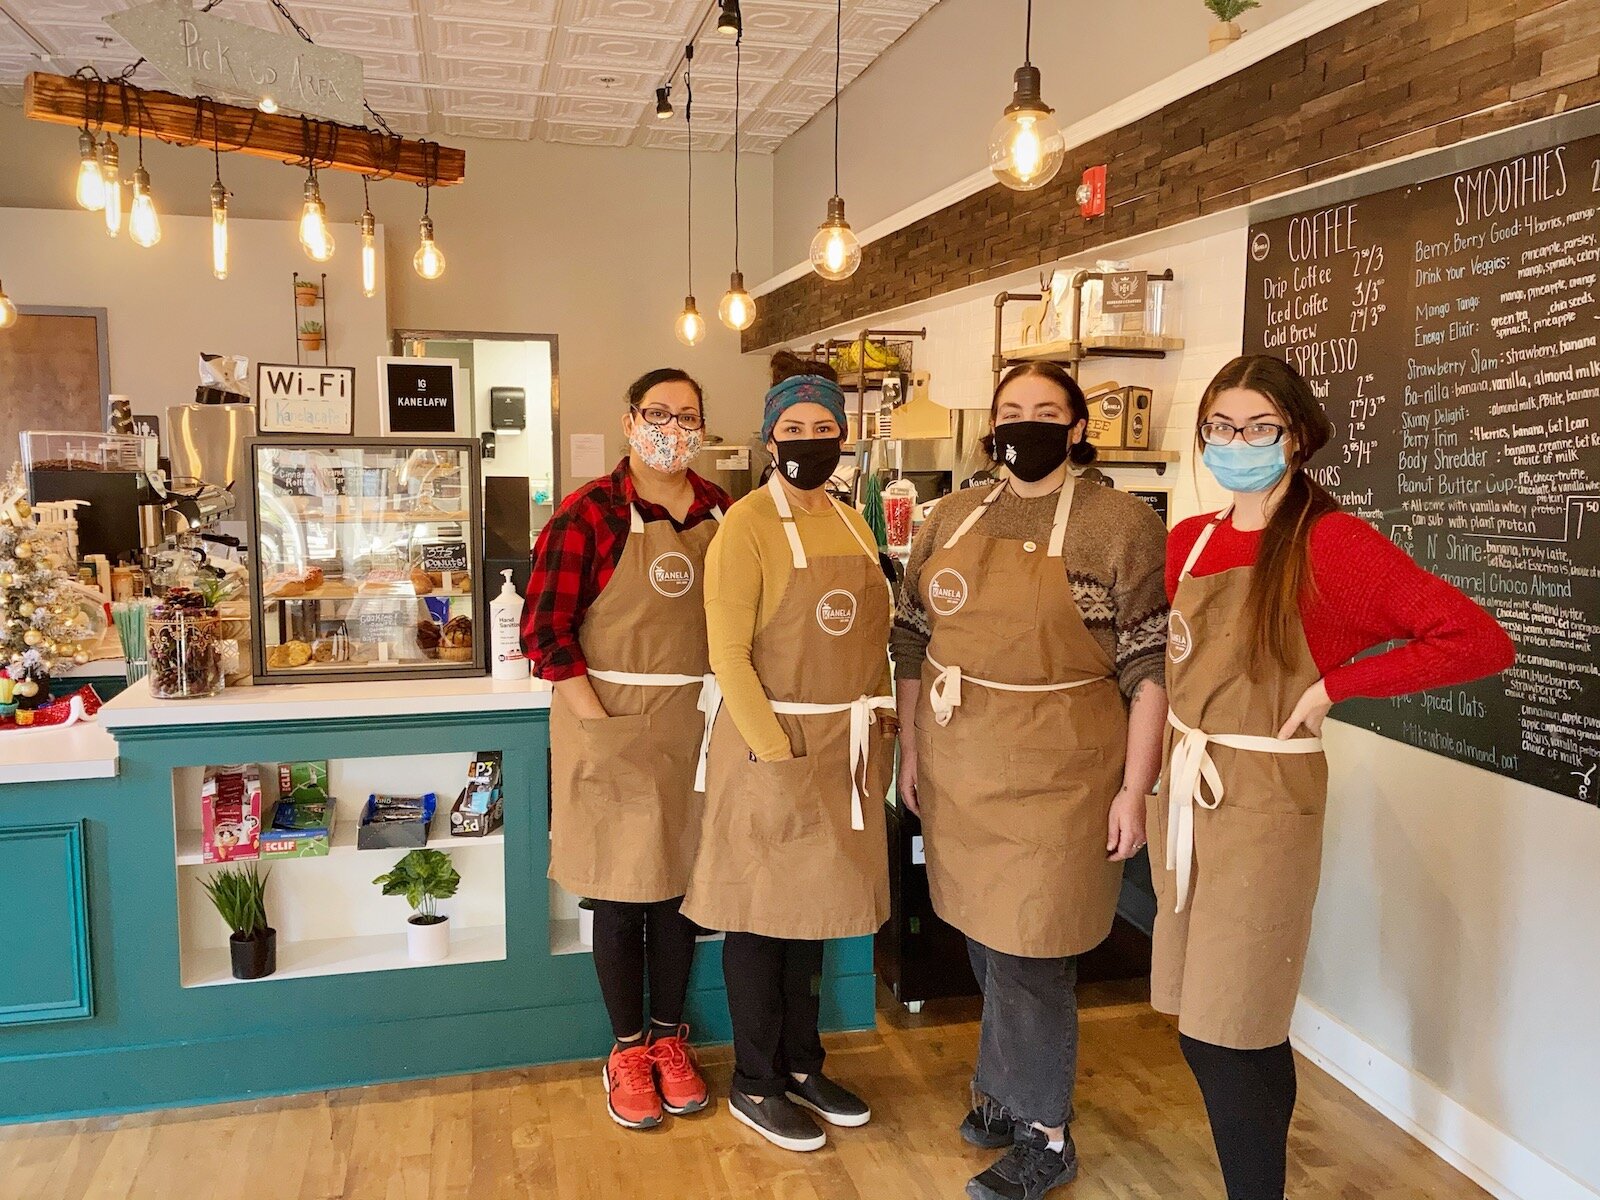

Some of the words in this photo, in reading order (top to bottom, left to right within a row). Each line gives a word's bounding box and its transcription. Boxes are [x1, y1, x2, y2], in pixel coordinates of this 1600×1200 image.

[1454, 146, 1567, 226] SMOOTHIES
[1288, 204, 1358, 262] COFFEE
[1453, 230, 1486, 253] Berry
[1264, 277, 1287, 299] Drip
[1294, 265, 1331, 291] Coffee
[1415, 267, 1442, 288] Drink
[1445, 265, 1466, 281] Your
[1267, 300, 1290, 326] Iced
[1295, 293, 1328, 319] Coffee
[1416, 303, 1450, 321] Mango
[1264, 326, 1286, 348] Cold
[1290, 323, 1317, 344] Brew
[1285, 338, 1358, 377] ESPRESSO
[1407, 356, 1466, 380] Strawberry
[1559, 335, 1597, 354] banana
[267, 371, 345, 397] Wi-Fi
[417, 378, 427, 388] IG
[1533, 363, 1574, 386] almond
[1310, 379, 1330, 398] Shot
[398, 398, 447, 407] KANELAFW
[1401, 411, 1431, 431] Skinny
[1403, 429, 1429, 449] Berry
[1398, 449, 1427, 473] Body
[1543, 451, 1553, 464] of
[1555, 449, 1579, 463] milk
[1303, 466, 1341, 487] VORS
[1397, 473, 1434, 495] Peanut
[1438, 473, 1481, 495] Butter
[1329, 488, 1374, 506] azelnut
[1448, 500, 1468, 512] with
[1470, 500, 1500, 513] vanilla
[1501, 500, 1527, 518] whey
[1428, 513, 1443, 527] sub
[1448, 515, 1468, 528] with
[1470, 515, 1495, 531] plant
[1497, 518, 1536, 533] protein
[1427, 533, 1438, 560] N
[1490, 572, 1528, 595] Choco
[1530, 574, 1571, 597] Almond
[270, 841, 295, 852] CLIF
